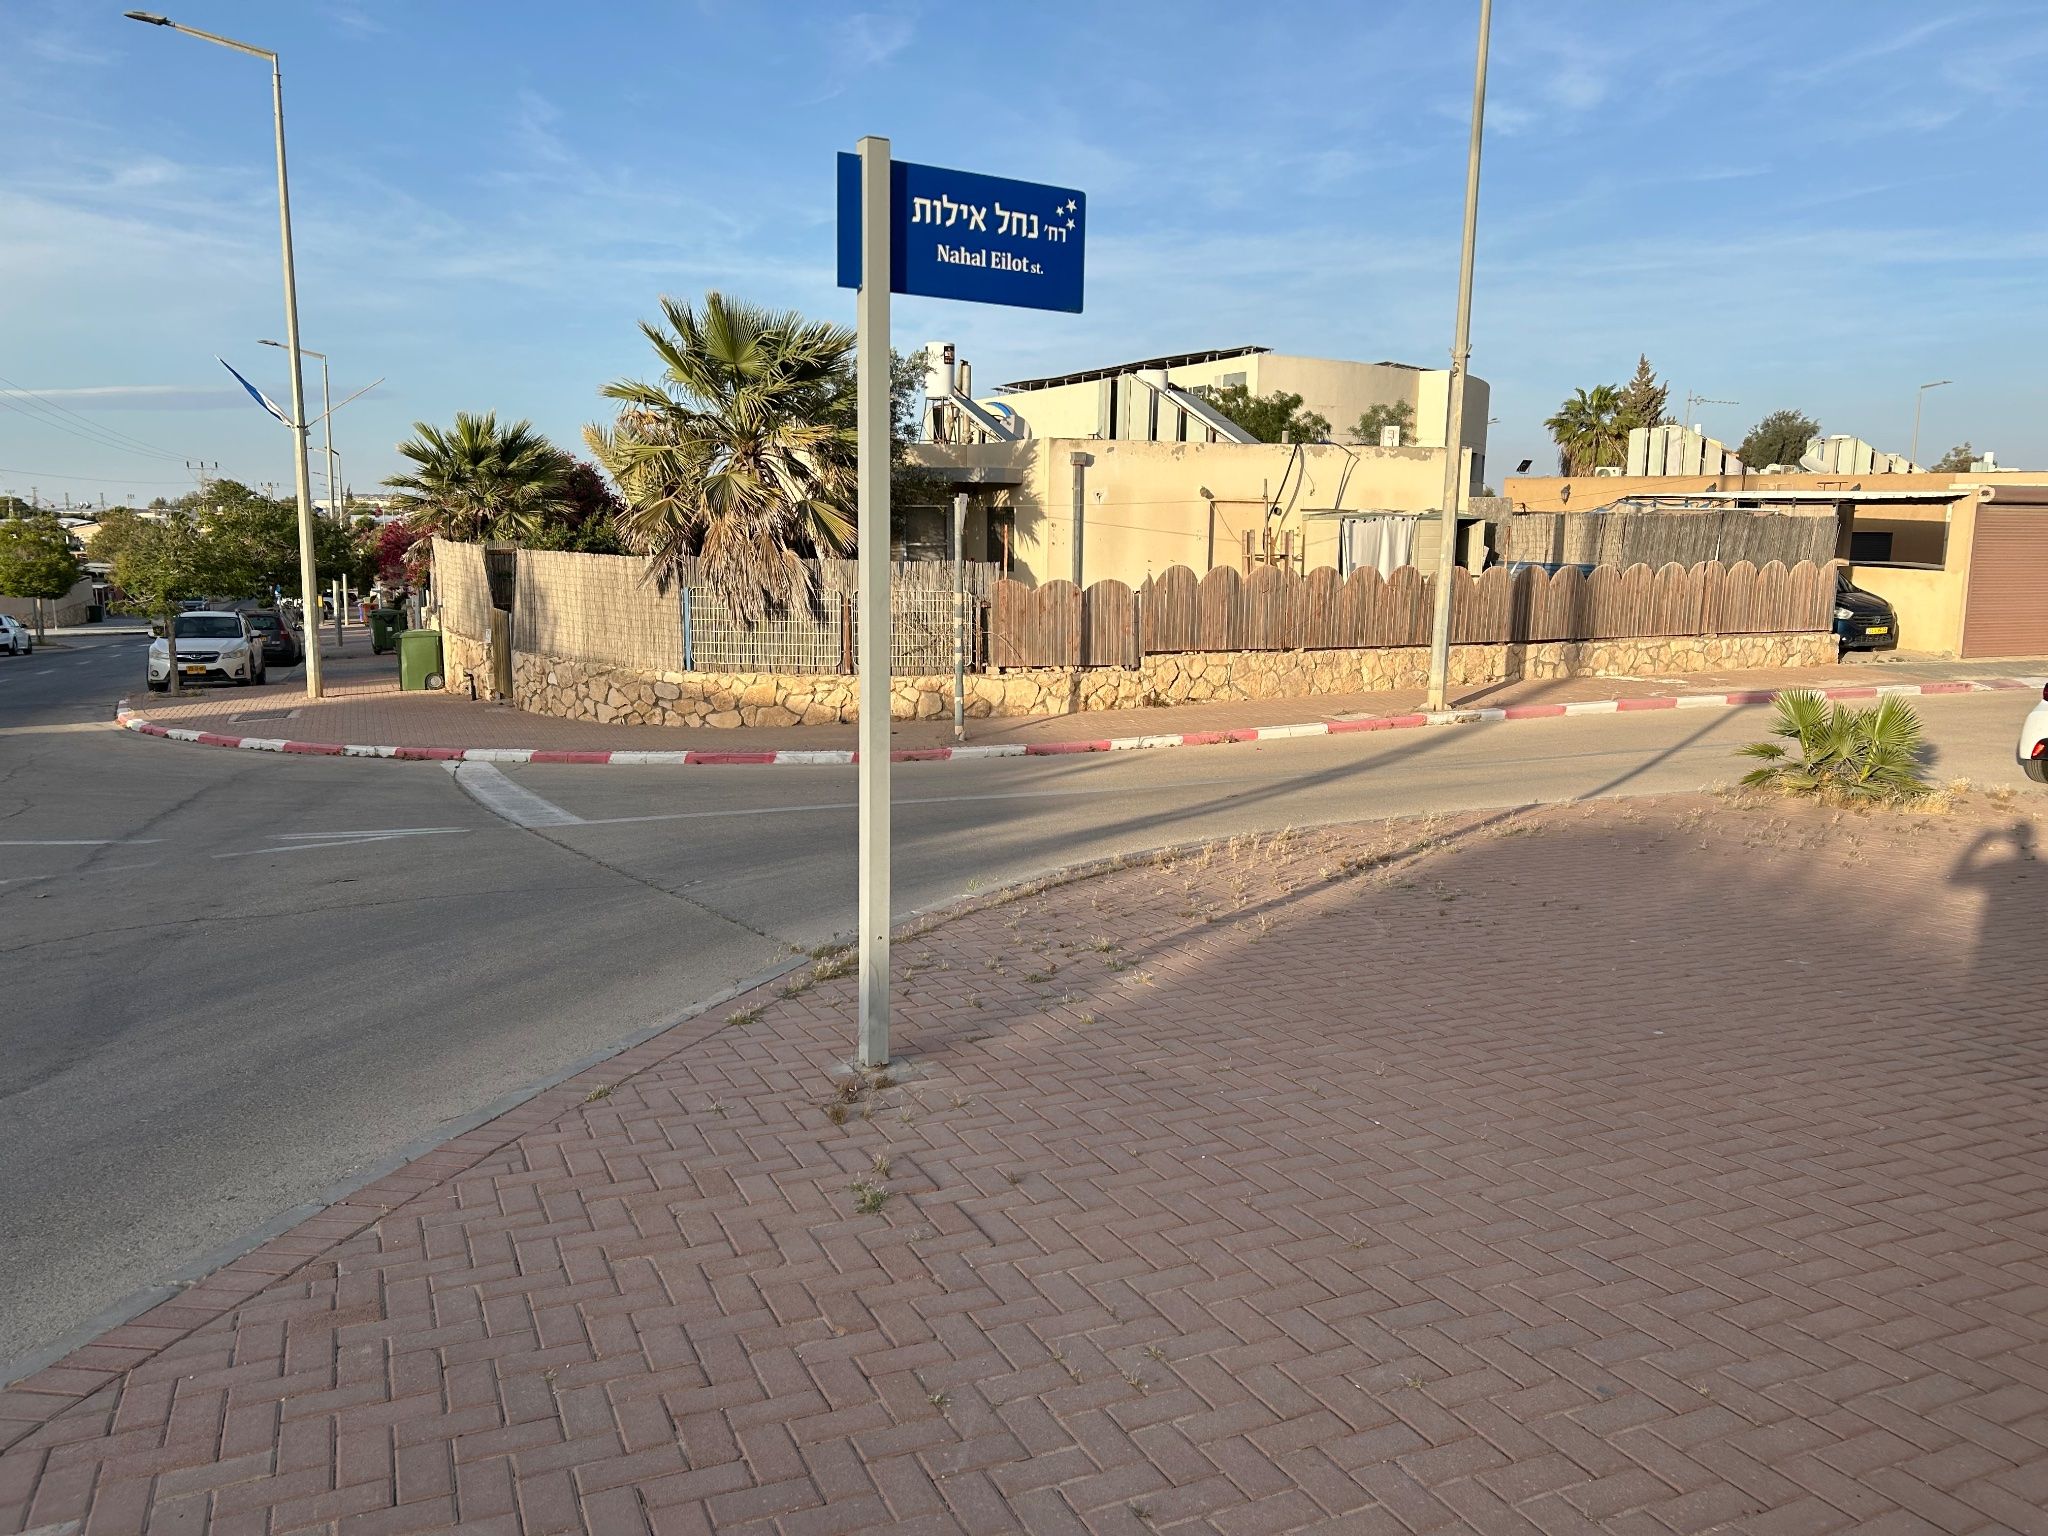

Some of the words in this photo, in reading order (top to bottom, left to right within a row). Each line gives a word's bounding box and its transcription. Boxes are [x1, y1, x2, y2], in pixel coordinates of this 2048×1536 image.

[911, 195, 987, 232] אילות
[995, 202, 1038, 239] נחל
[937, 244, 987, 267] Nahal
[991, 251, 1029, 272] Eilot
[1030, 263, 1044, 275] st.
